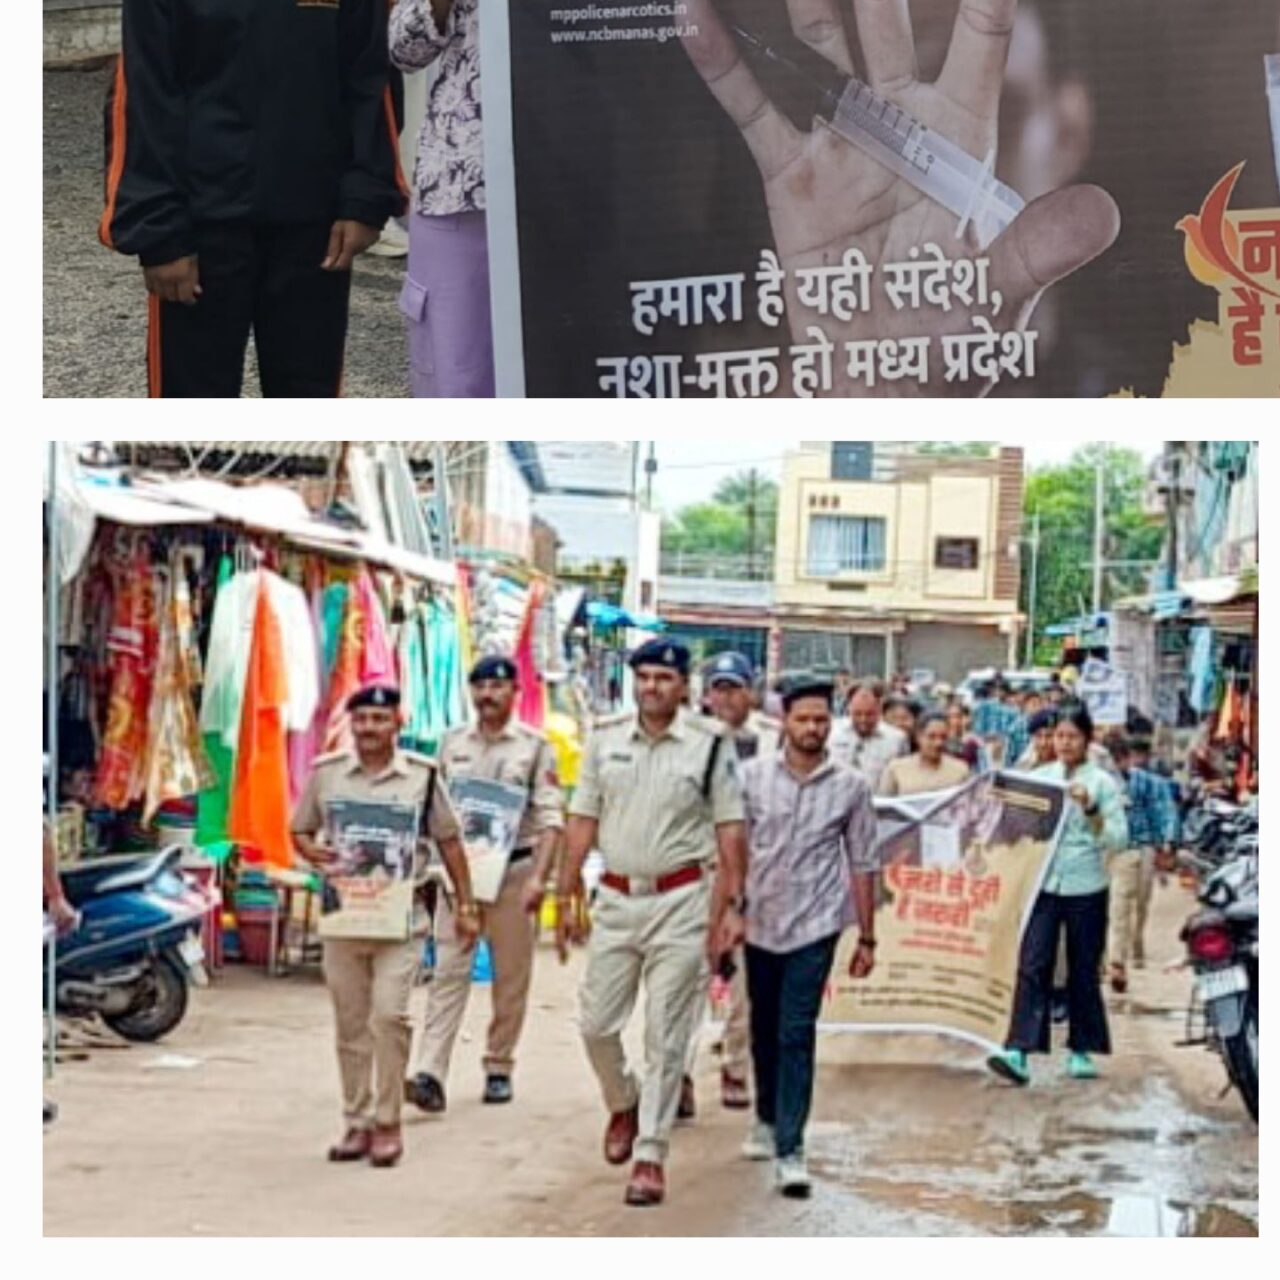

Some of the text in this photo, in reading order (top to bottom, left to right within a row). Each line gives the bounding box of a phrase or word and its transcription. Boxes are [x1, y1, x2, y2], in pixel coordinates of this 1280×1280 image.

[550, 1, 688, 24] mppolicenarcotics.in
[551, 23, 699, 43] www.ncbmanas.gov.in
[629, 242, 1003, 335] हमारा है यही संदेश,
[1227, 287, 1265, 366] है
[789, 326, 834, 398] हो
[846, 336, 930, 387] मध्य
[941, 316, 1039, 385] प्रदेश
